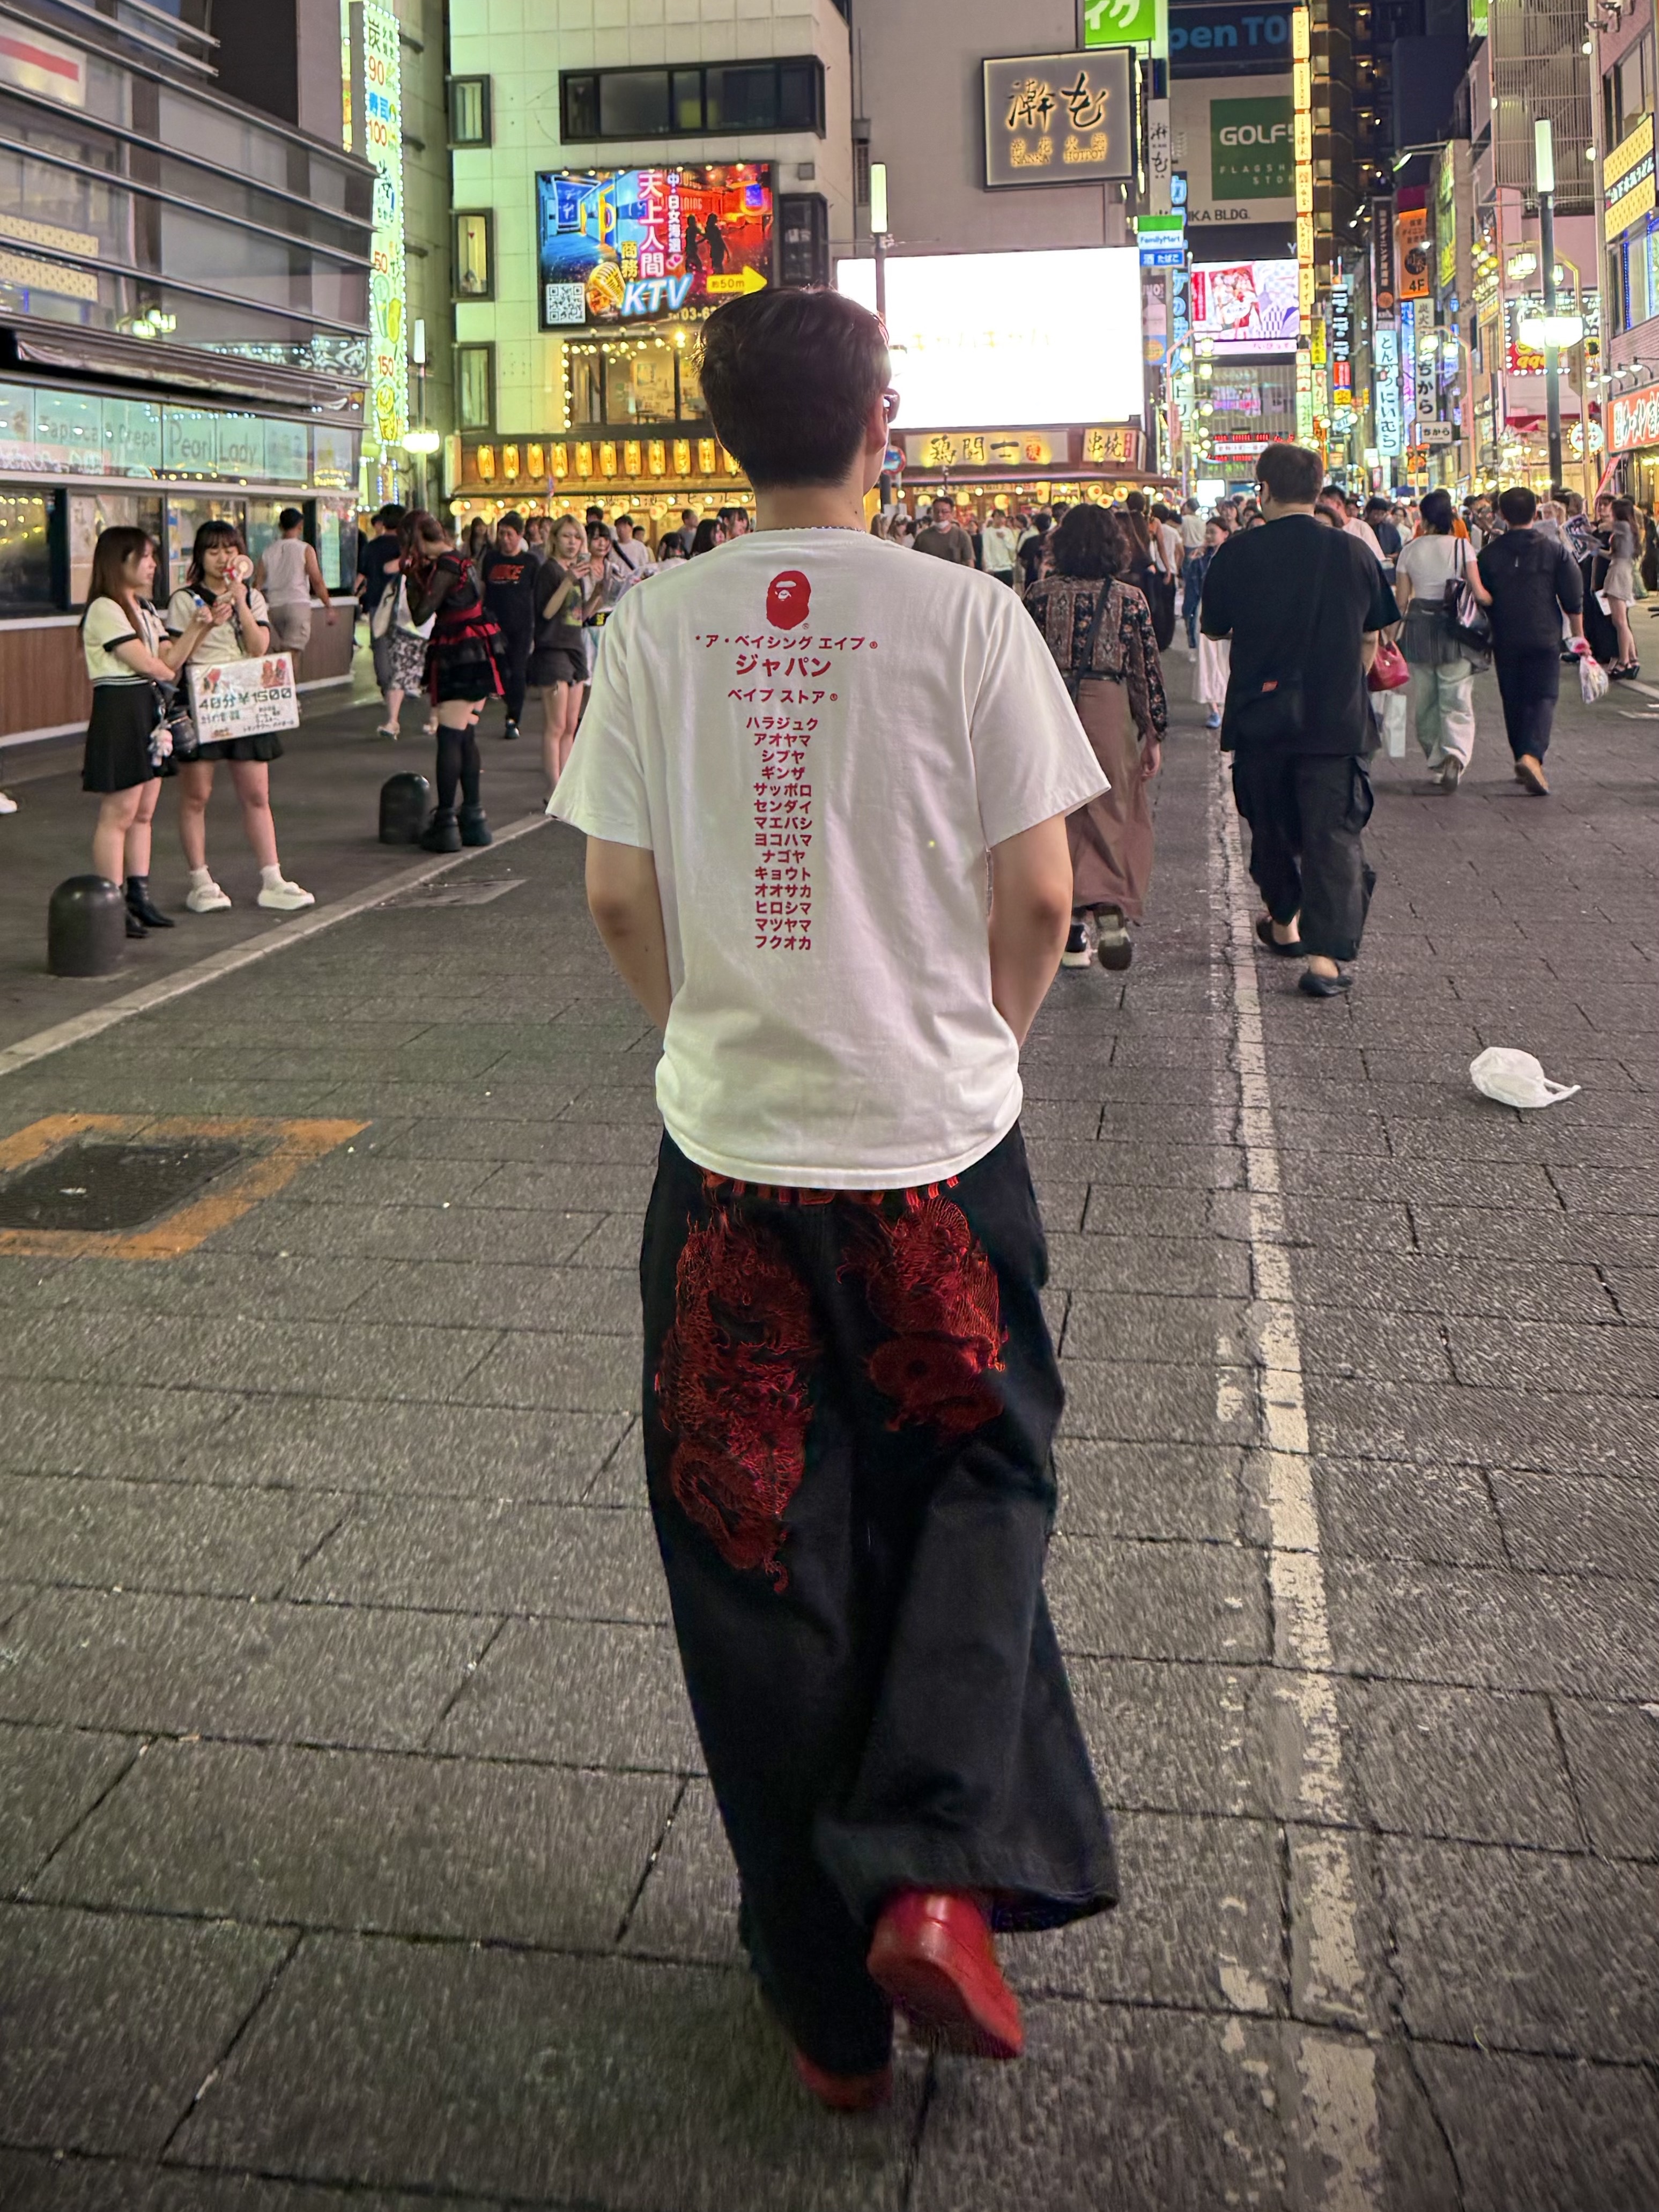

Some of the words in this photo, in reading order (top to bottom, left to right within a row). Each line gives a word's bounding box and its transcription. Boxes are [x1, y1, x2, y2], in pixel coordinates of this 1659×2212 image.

[368, 55, 384, 86] 90
[638, 173, 664, 277] 天上人間
[1140, 236, 1180, 244] FamilyMart
[621, 241, 638, 277] 商務
[1157, 254, 1180, 263] たばこ
[1409, 279, 1425, 292] 4F
[621, 273, 694, 316] KTV
[169, 421, 212, 460] Pearl
[219, 431, 257, 466] Lady
[736, 654, 832, 677] ジャパン
[746, 716, 818, 731] ハラジュク
[754, 733, 811, 747] アオヤマ
[762, 749, 805, 763] シブヤ
[761, 766, 805, 780] ギンザ
[753, 783, 812, 797] サッポロ
[754, 800, 812, 813] センダイ
[754, 817, 812, 830] マエバシ
[755, 833, 812, 846] ヨコハマ
[762, 850, 805, 863] ナゴヤ
[755, 867, 811, 881] キョウト
[755, 884, 812, 898] オオサカ
[756, 901, 812, 914] ヒロシマ
[755, 918, 812, 931] マツヤマ
[755, 935, 812, 950] フクオカ
